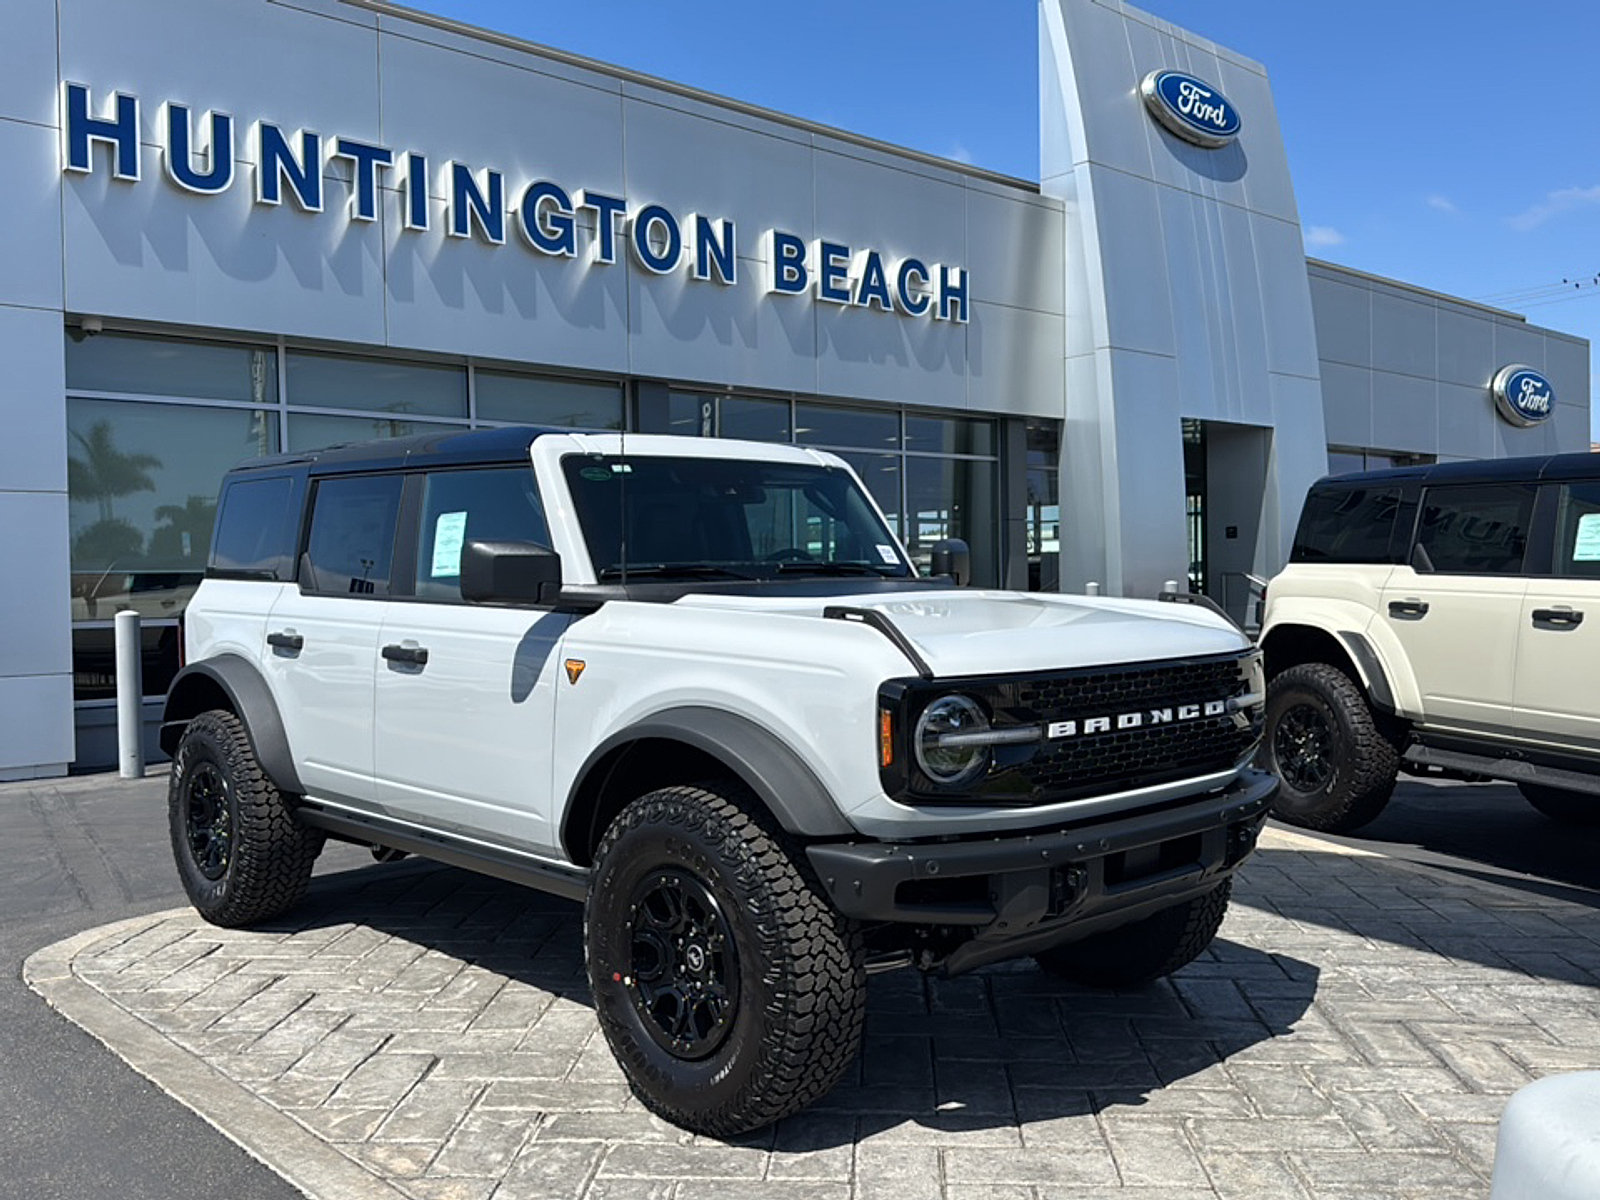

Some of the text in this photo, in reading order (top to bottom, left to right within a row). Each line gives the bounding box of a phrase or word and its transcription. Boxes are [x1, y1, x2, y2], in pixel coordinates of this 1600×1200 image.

[1178, 81, 1227, 127] Ford
[62, 80, 970, 324] HUNTINGTON BEACH
[1518, 377, 1550, 413] Ford
[1048, 700, 1225, 738] BRONCO
